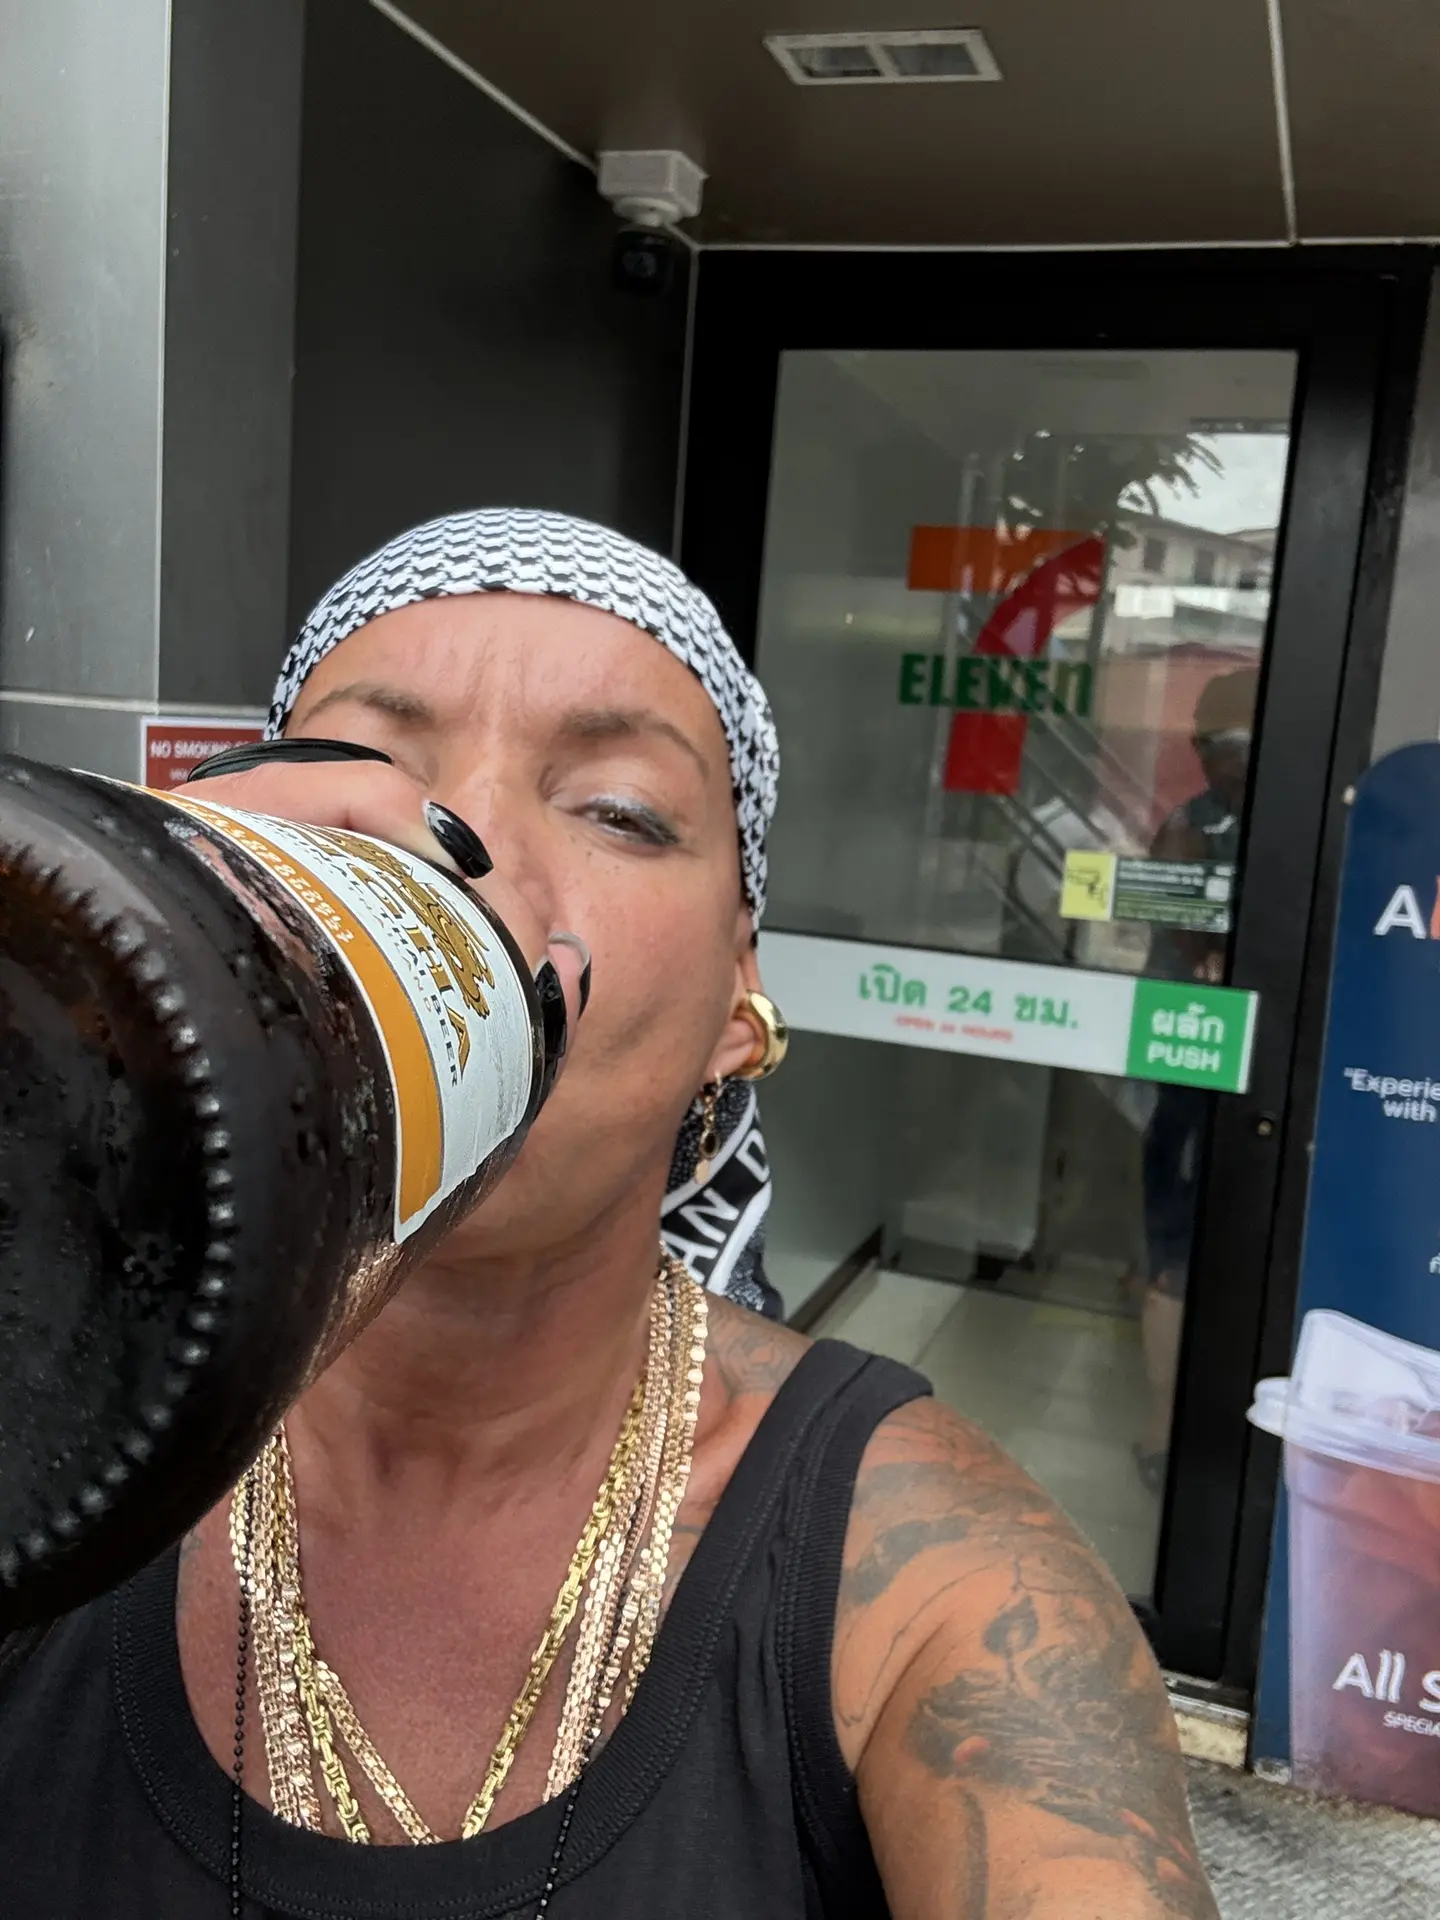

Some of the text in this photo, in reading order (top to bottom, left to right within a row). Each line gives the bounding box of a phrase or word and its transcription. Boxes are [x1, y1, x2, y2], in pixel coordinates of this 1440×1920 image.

[150, 740, 172, 758] NO
[245, 810, 471, 1083] NGHA
[380, 907, 427, 977] THAI
[431, 994, 458, 1088] BEER
[858, 962, 928, 1007] เปิด
[947, 985, 993, 1017] 24
[1151, 1001, 1225, 1044] ผลัก
[1146, 1039, 1221, 1074] PUSH
[1383, 1098, 1437, 1123] with
[1332, 1648, 1406, 1704] All
